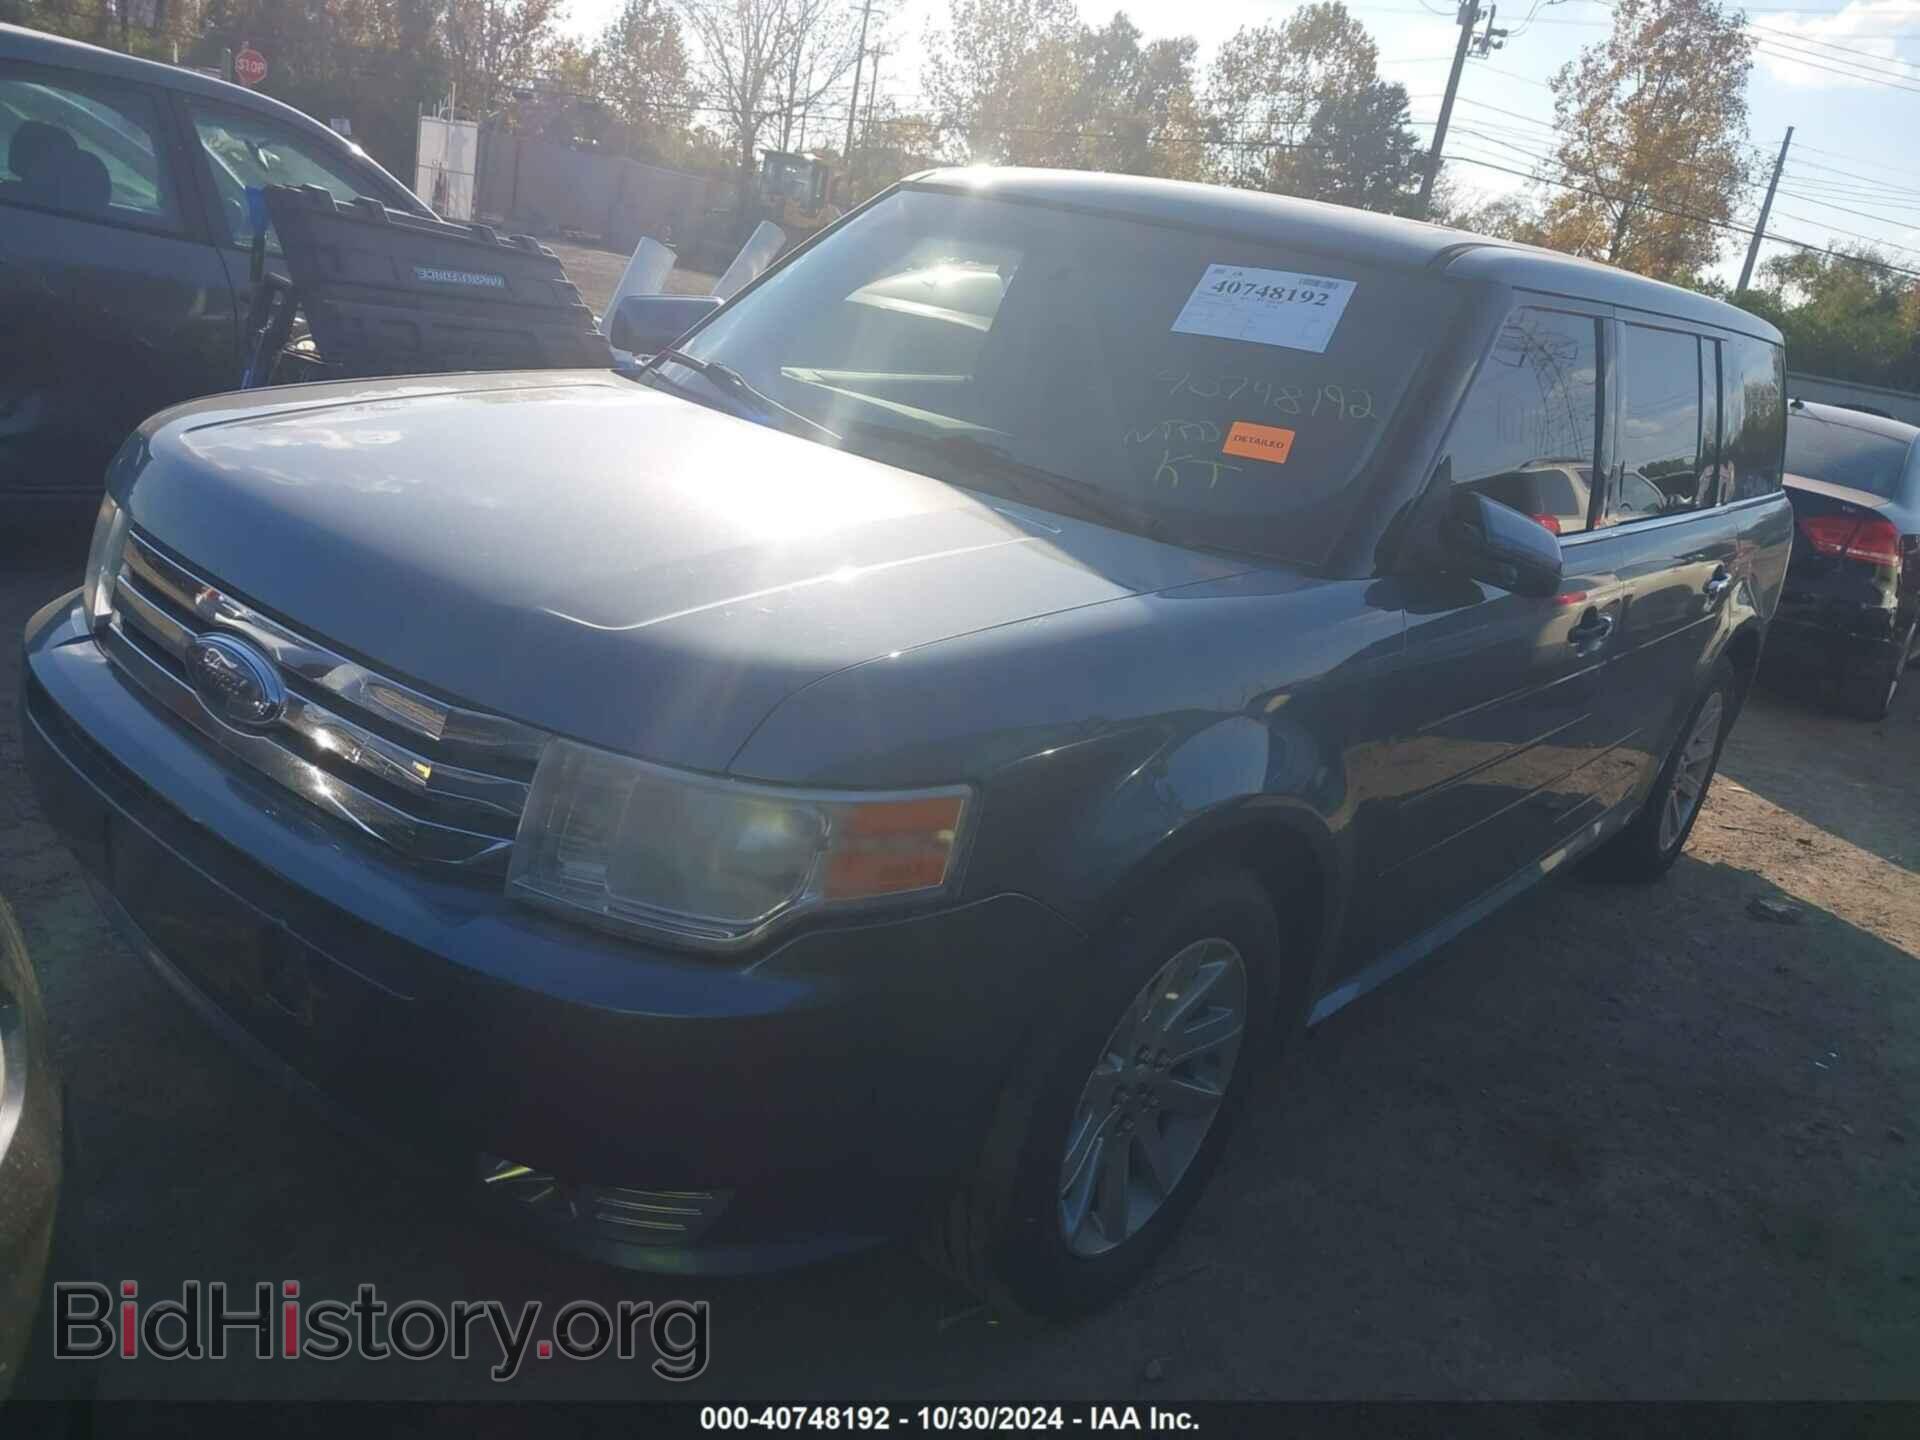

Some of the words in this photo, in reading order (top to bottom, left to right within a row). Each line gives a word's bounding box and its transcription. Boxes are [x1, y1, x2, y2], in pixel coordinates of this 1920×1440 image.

[237, 58, 265, 74] STOP
[1211, 280, 1329, 306] 40748192
[1232, 433, 1286, 450] DETAILED
